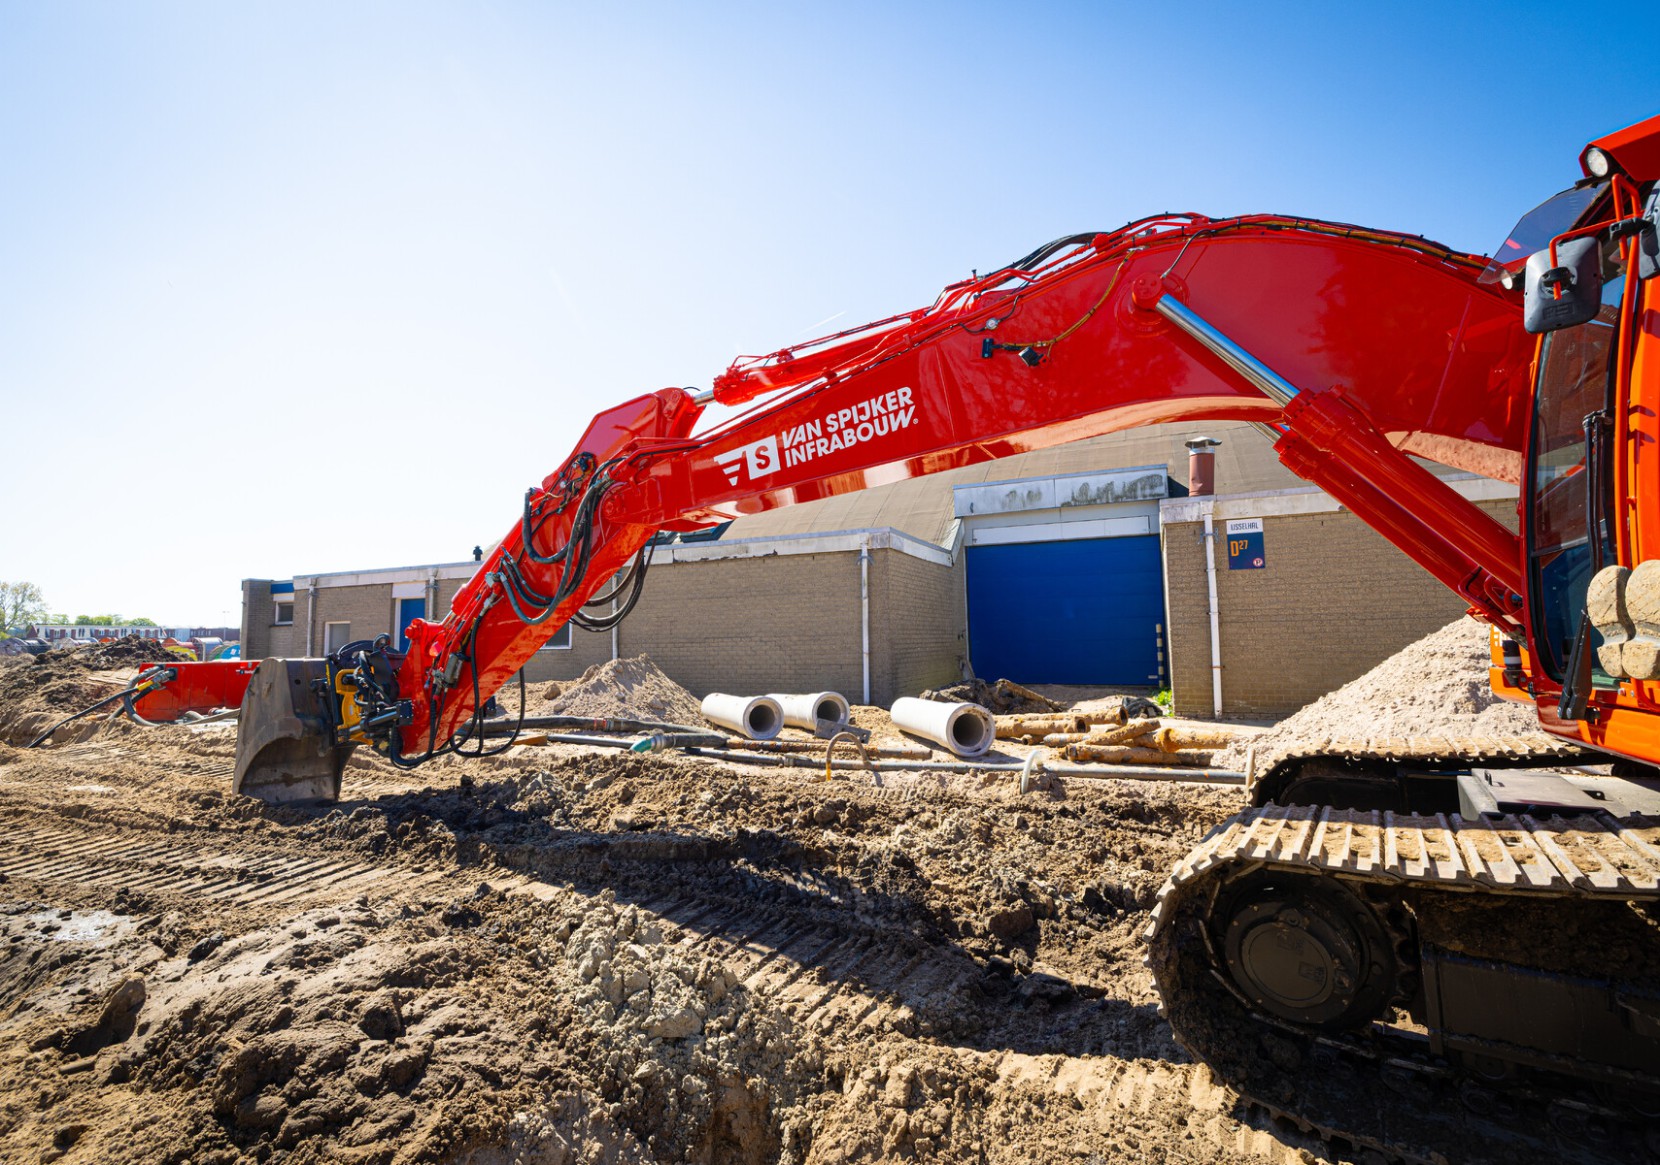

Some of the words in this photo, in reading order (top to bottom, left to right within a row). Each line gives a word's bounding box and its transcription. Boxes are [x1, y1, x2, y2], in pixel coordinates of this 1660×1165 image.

[782, 419, 822, 449] VAN
[826, 386, 914, 433] SPIJKER
[755, 445, 771, 470] S
